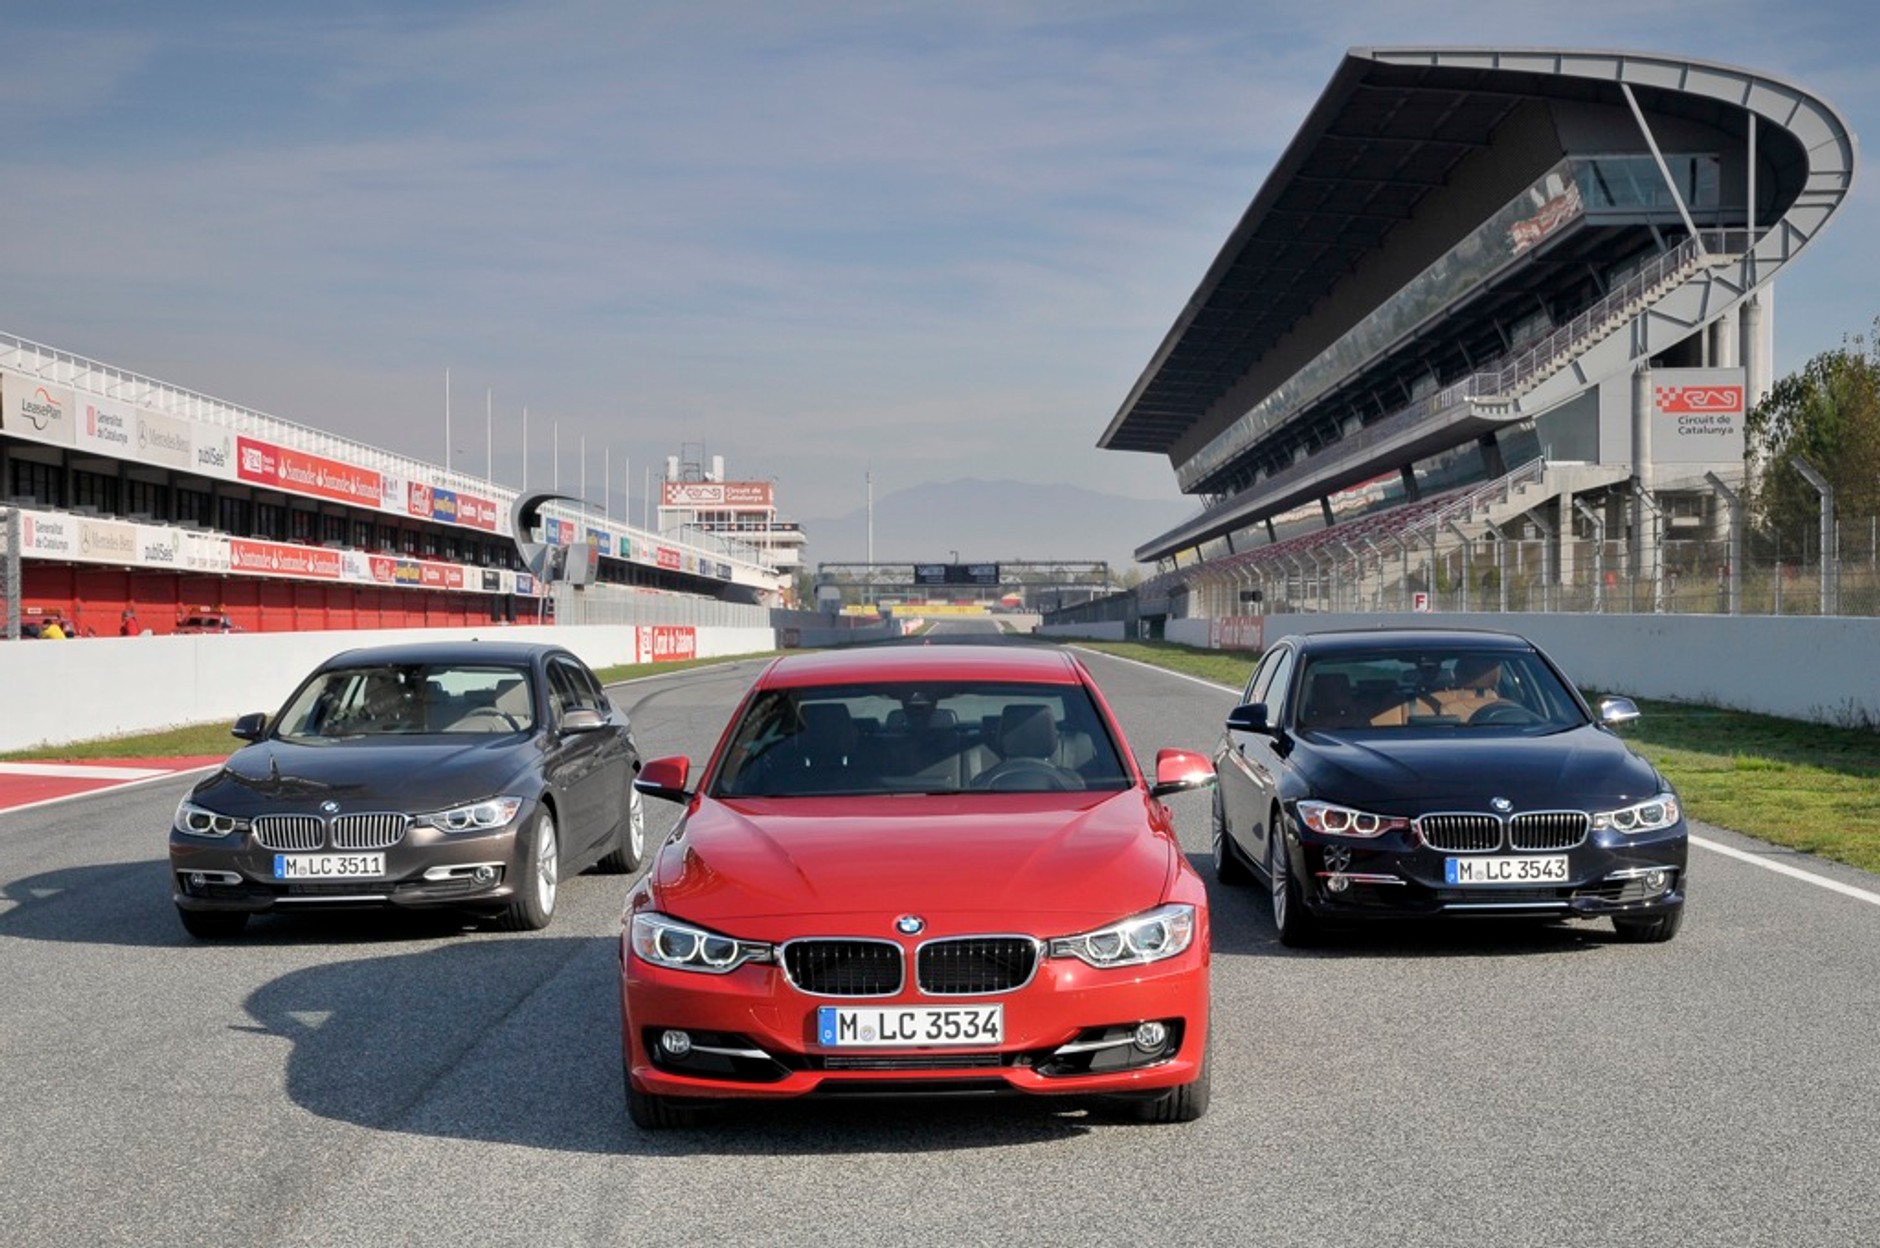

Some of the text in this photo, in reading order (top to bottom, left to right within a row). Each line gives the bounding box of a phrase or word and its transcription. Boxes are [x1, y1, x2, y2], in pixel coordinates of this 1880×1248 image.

[22, 398, 61, 419] LeasePlan
[97, 410, 122, 427] Generalitat
[1678, 415, 1731, 425] Circuit de
[1678, 425, 1734, 436] Catalunya
[1415, 594, 1426, 609] F
[286, 856, 381, 875] M LC 3511
[1459, 859, 1566, 880] M LC 3543
[839, 1010, 998, 1041] M LC 3534
